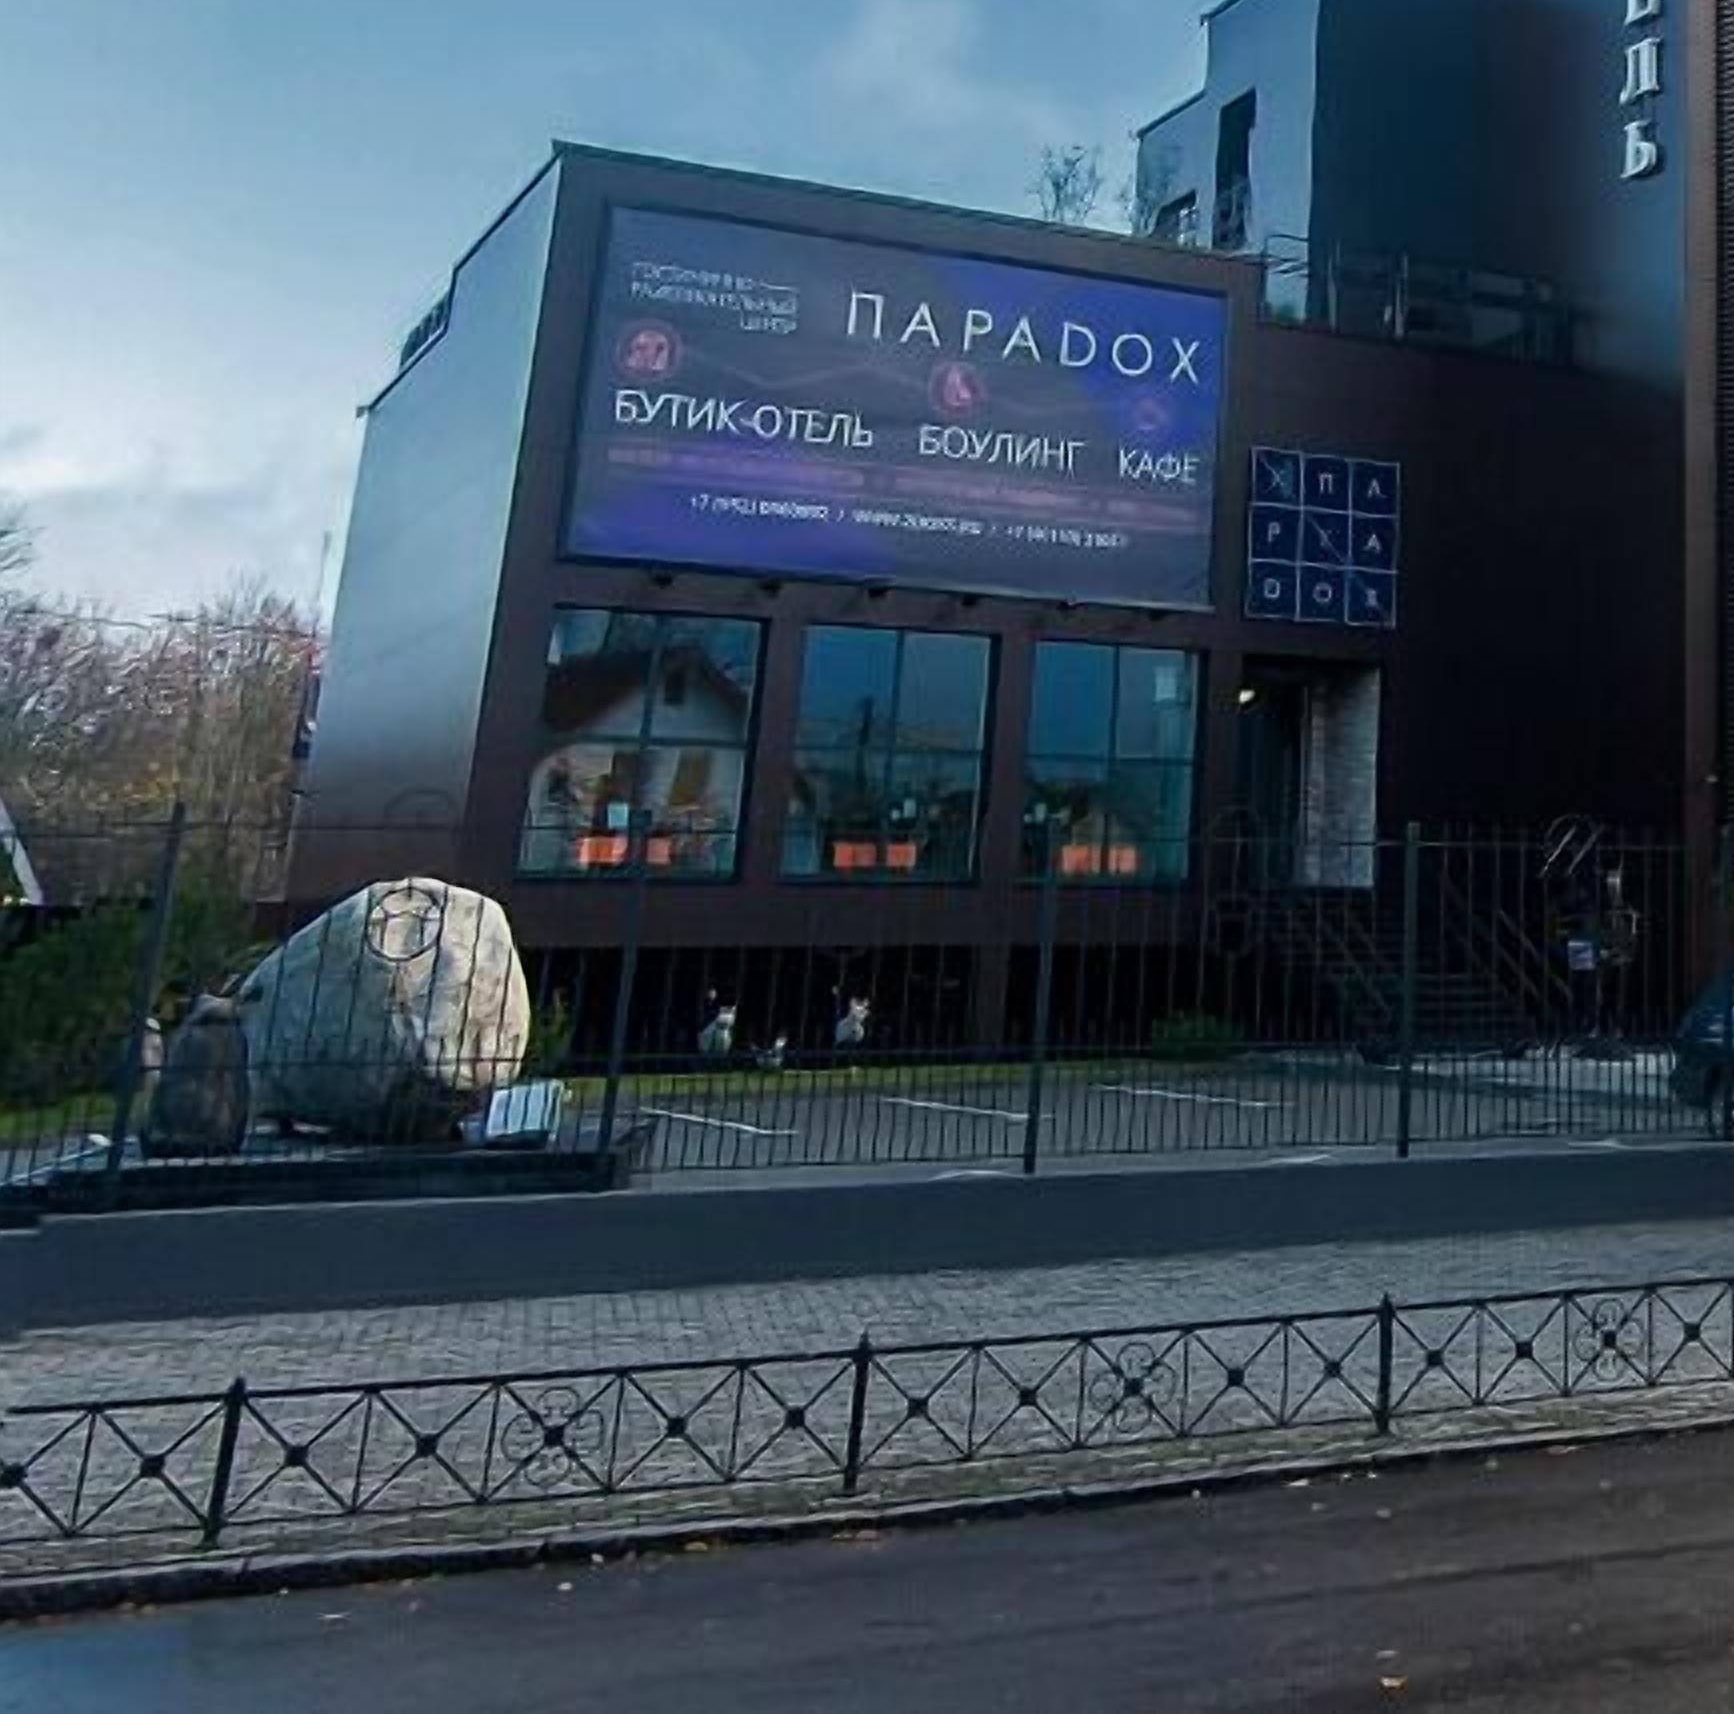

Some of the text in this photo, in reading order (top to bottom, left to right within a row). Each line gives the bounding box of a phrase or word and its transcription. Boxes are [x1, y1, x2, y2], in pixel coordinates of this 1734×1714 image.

[615, 388, 1200, 483] БУТИК-ОТЕЛЬ БОУЛИНГ КАФЕ
